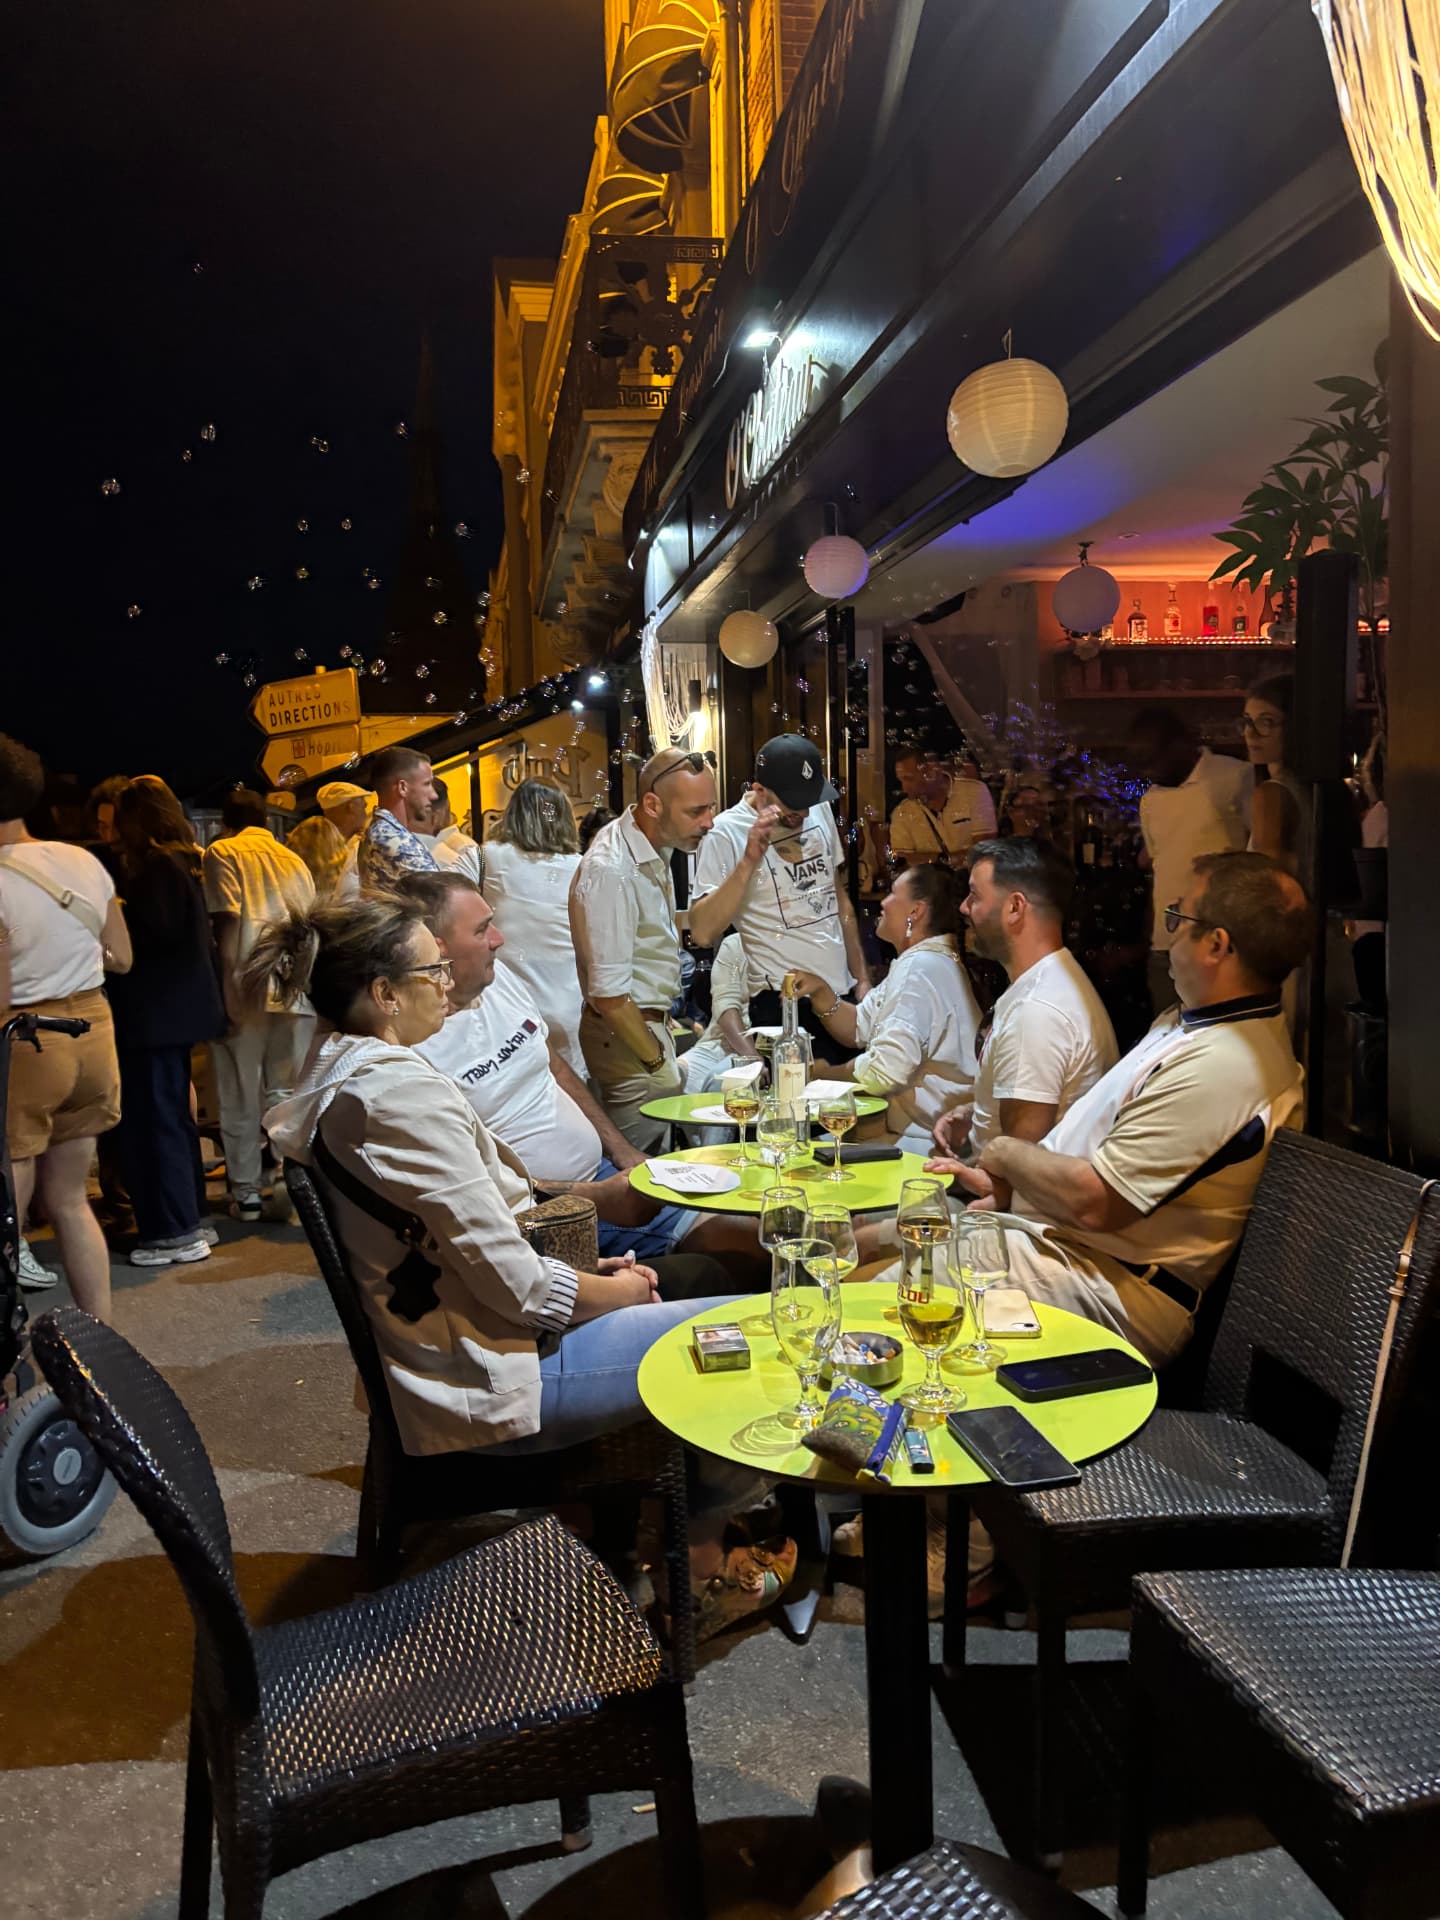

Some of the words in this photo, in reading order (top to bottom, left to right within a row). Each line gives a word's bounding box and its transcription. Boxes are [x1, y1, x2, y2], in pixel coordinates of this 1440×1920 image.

[269, 700, 352, 727] DIRECTIONS
[784, 855, 826, 883] VANS
[462, 1059, 499, 1084] TEDDY
